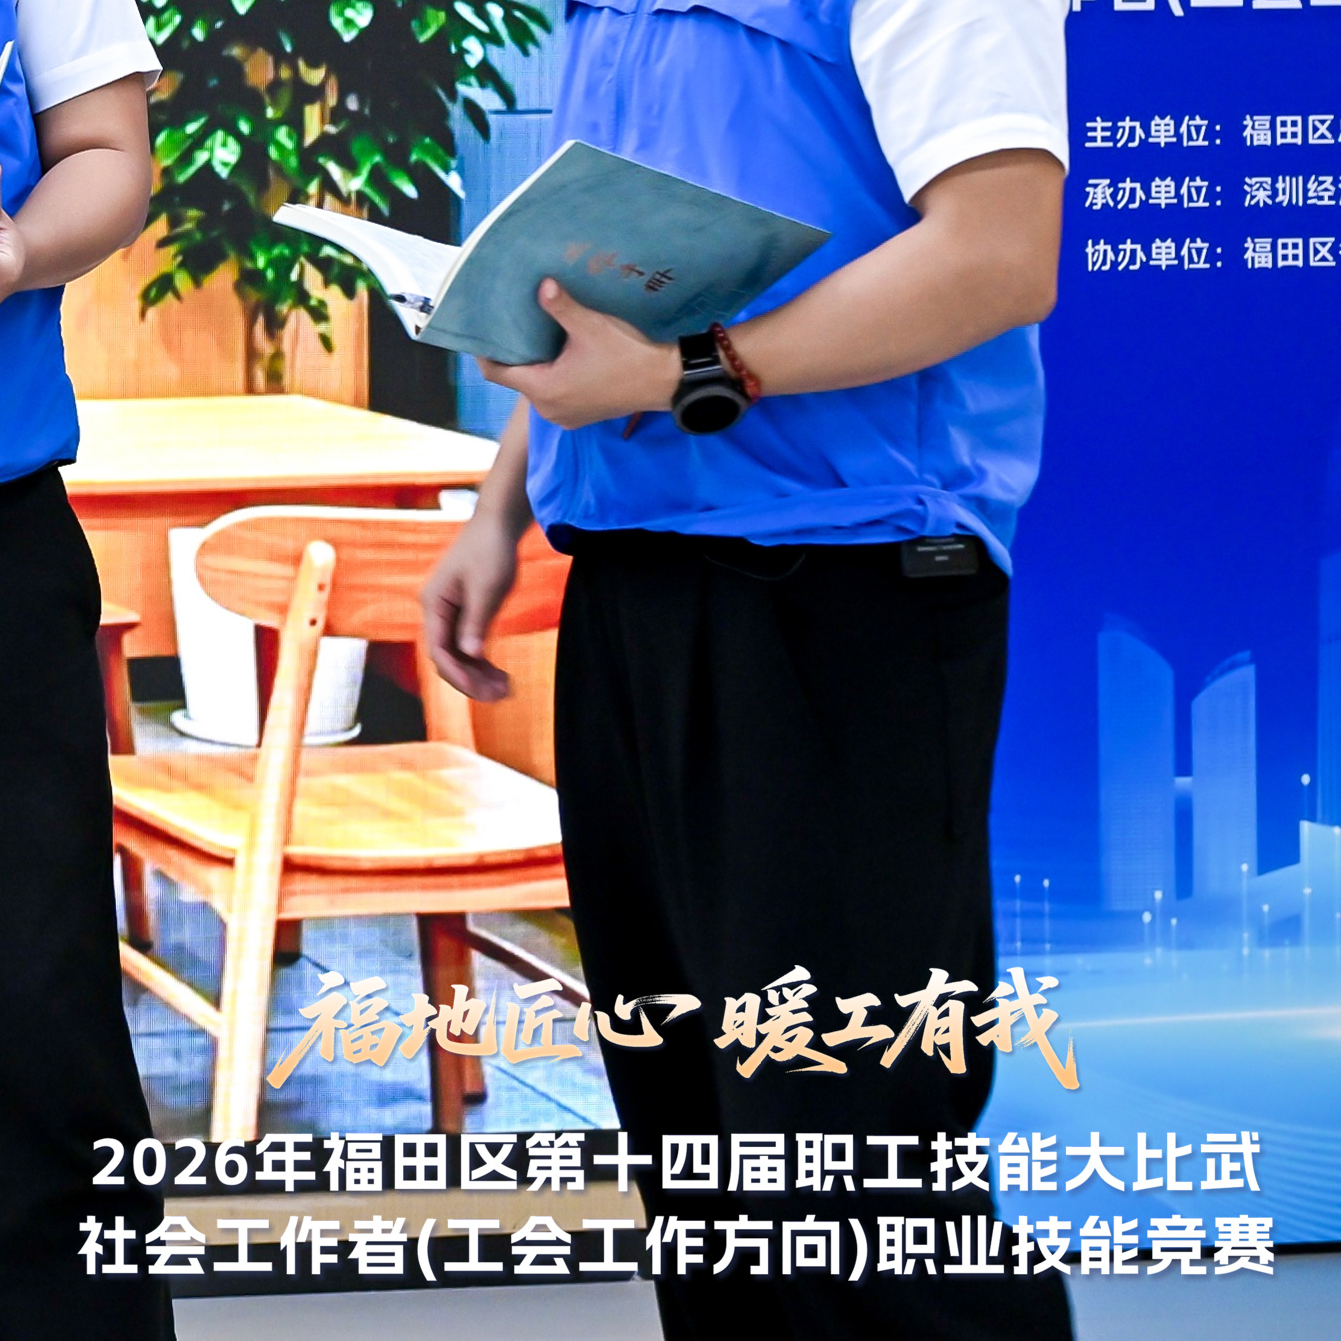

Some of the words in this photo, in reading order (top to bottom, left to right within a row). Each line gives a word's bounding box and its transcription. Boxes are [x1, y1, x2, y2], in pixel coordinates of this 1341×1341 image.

[1085, 115, 1341, 148] 主办单位：福田区
[1085, 175, 1341, 210] 承办单位：深圳经
[1085, 237, 1341, 271] 协办单位：福田区
